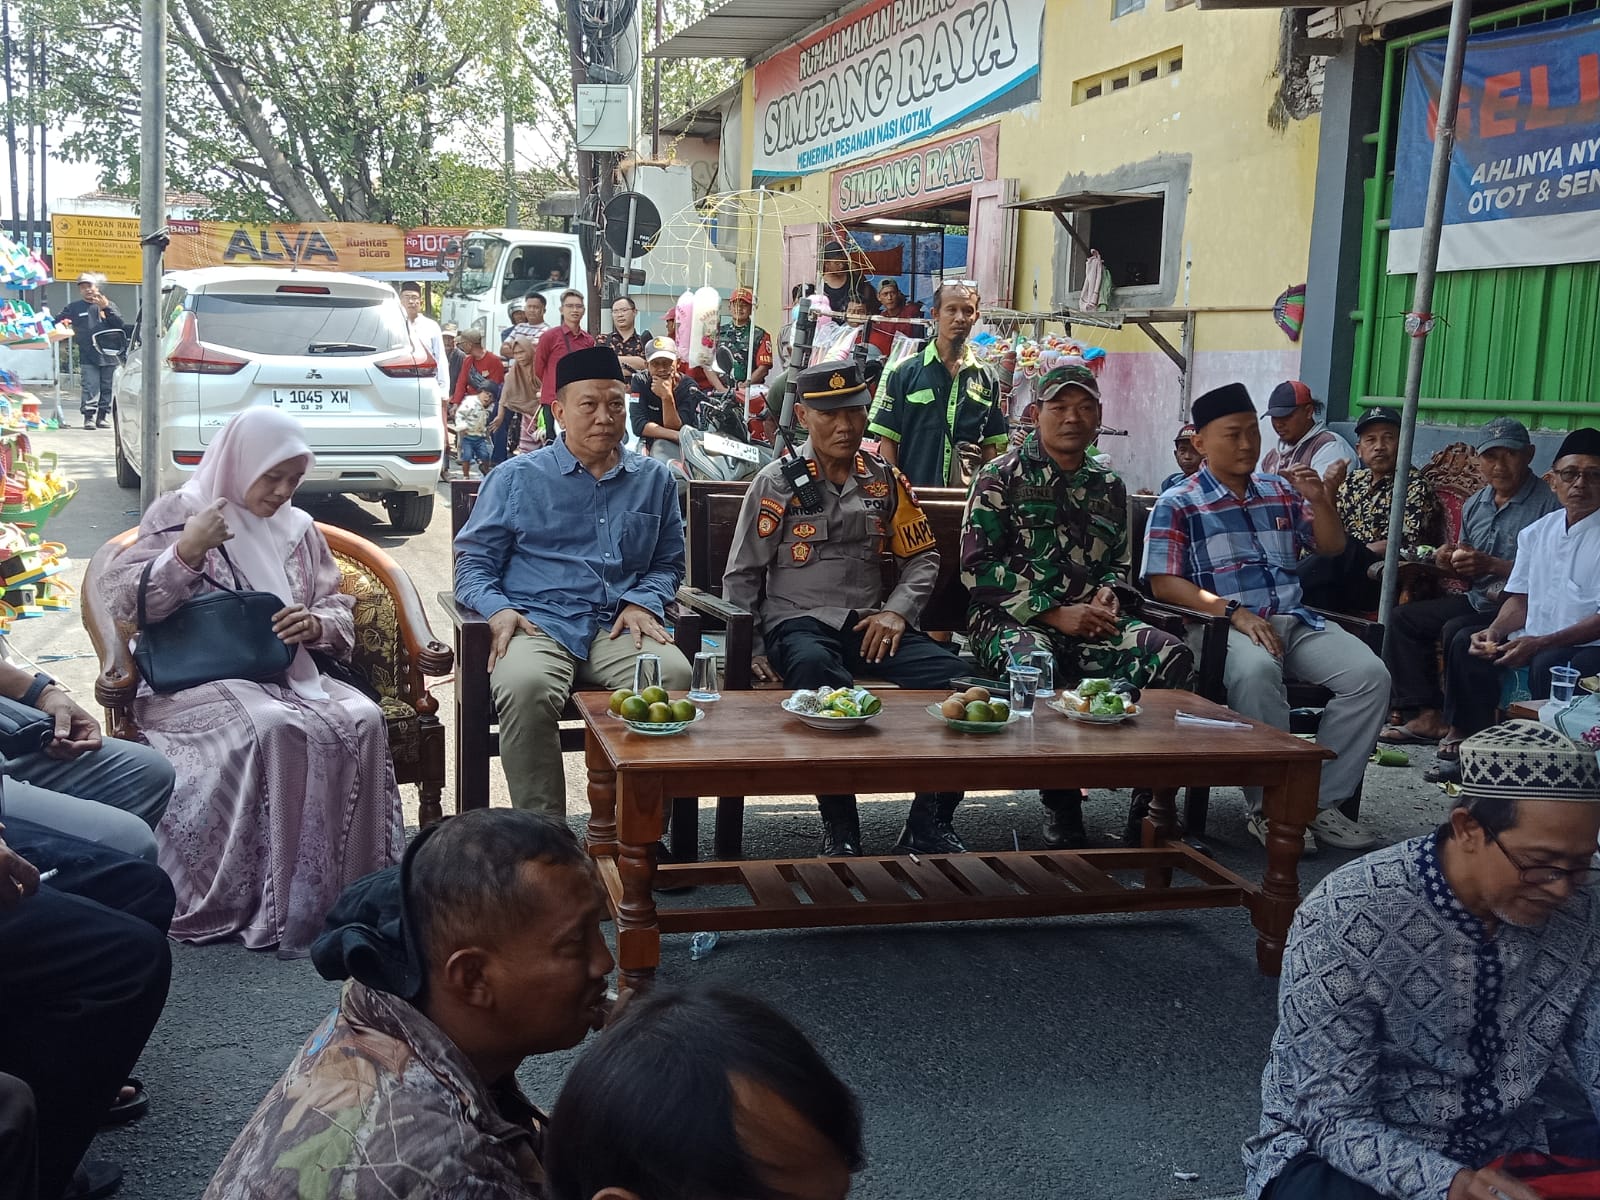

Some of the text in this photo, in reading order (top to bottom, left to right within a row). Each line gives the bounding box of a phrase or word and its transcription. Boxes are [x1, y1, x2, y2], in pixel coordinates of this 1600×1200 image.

[799, 35, 840, 81] RUMAH
[841, 4, 891, 62] MAKAN
[763, 0, 1018, 156] SIMPANG RAYA
[797, 106, 932, 170] MENERIMA PESANAN NASI KOTAK
[839, 137, 984, 212] SIMPANG RAYA
[1471, 147, 1562, 185] AHLINYA
[1468, 182, 1532, 214] OTOT
[1535, 179, 1550, 203] &
[77, 219, 114, 228] KAWASAN
[78, 228, 114, 237] BENCANA
[223, 229, 338, 261] ALVA
[346, 237, 388, 247] Kualitas
[359, 248, 390, 258] Bicara
[407, 257, 421, 268] 12
[273, 390, 349, 404] L 1045 XW
